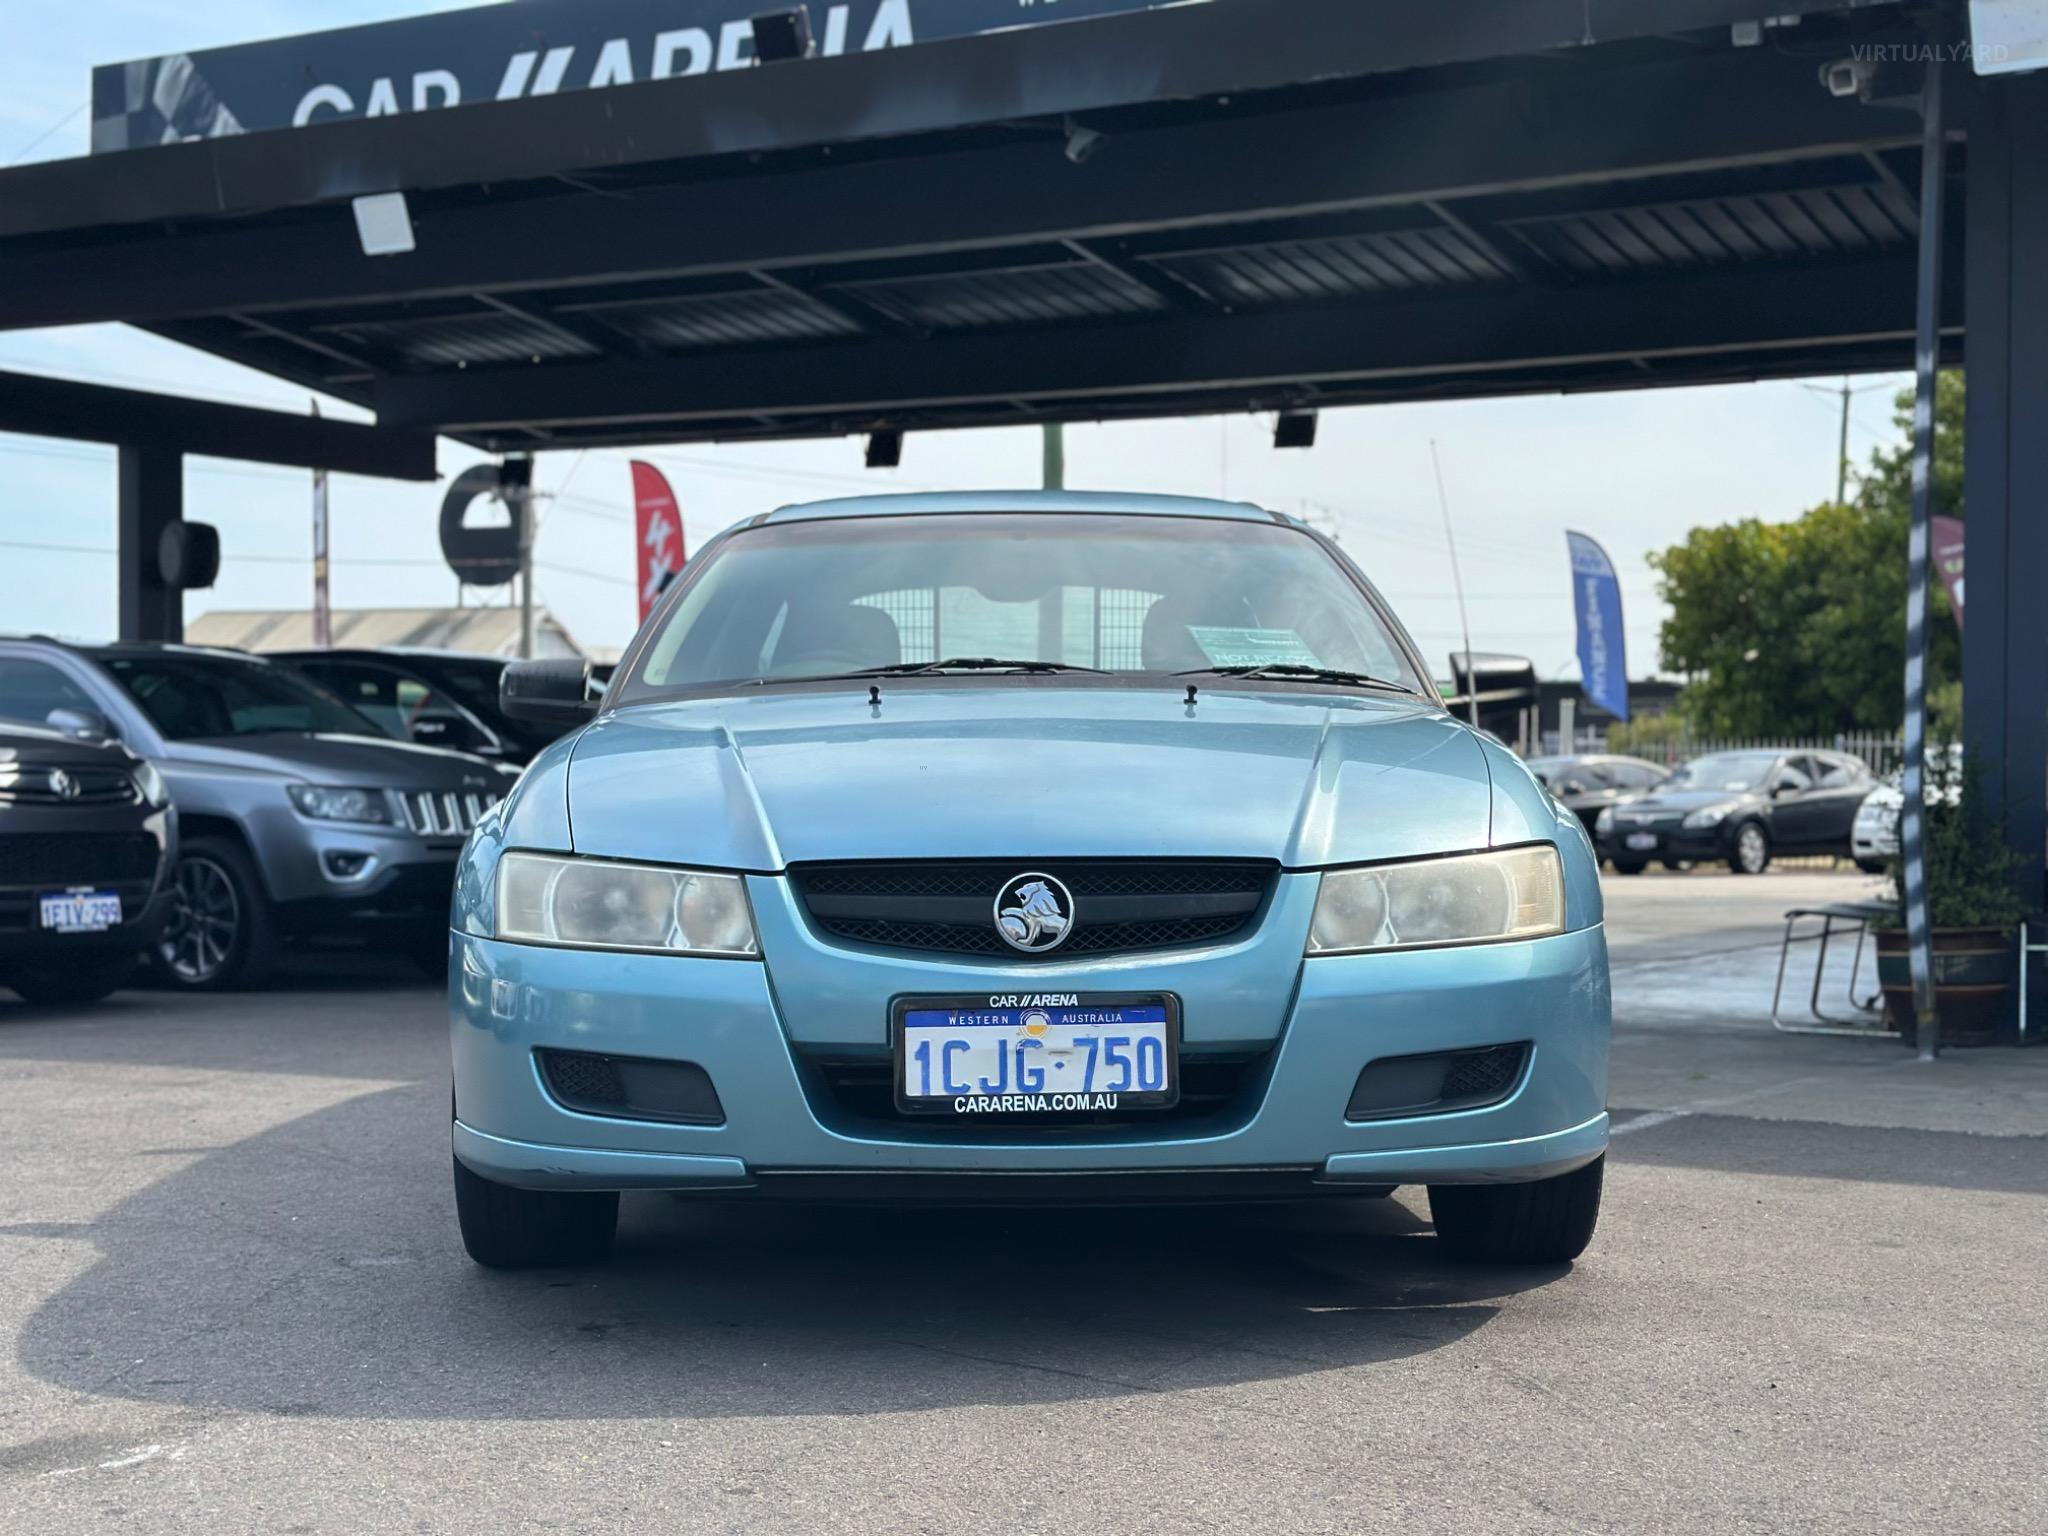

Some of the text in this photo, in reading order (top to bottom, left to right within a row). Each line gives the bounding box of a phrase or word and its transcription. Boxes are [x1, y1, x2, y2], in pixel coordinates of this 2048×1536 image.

[949, 1013, 1122, 1026] WESTERN AUSTRALIA
[954, 1094, 1118, 1114] CARARENA.COM.AU
